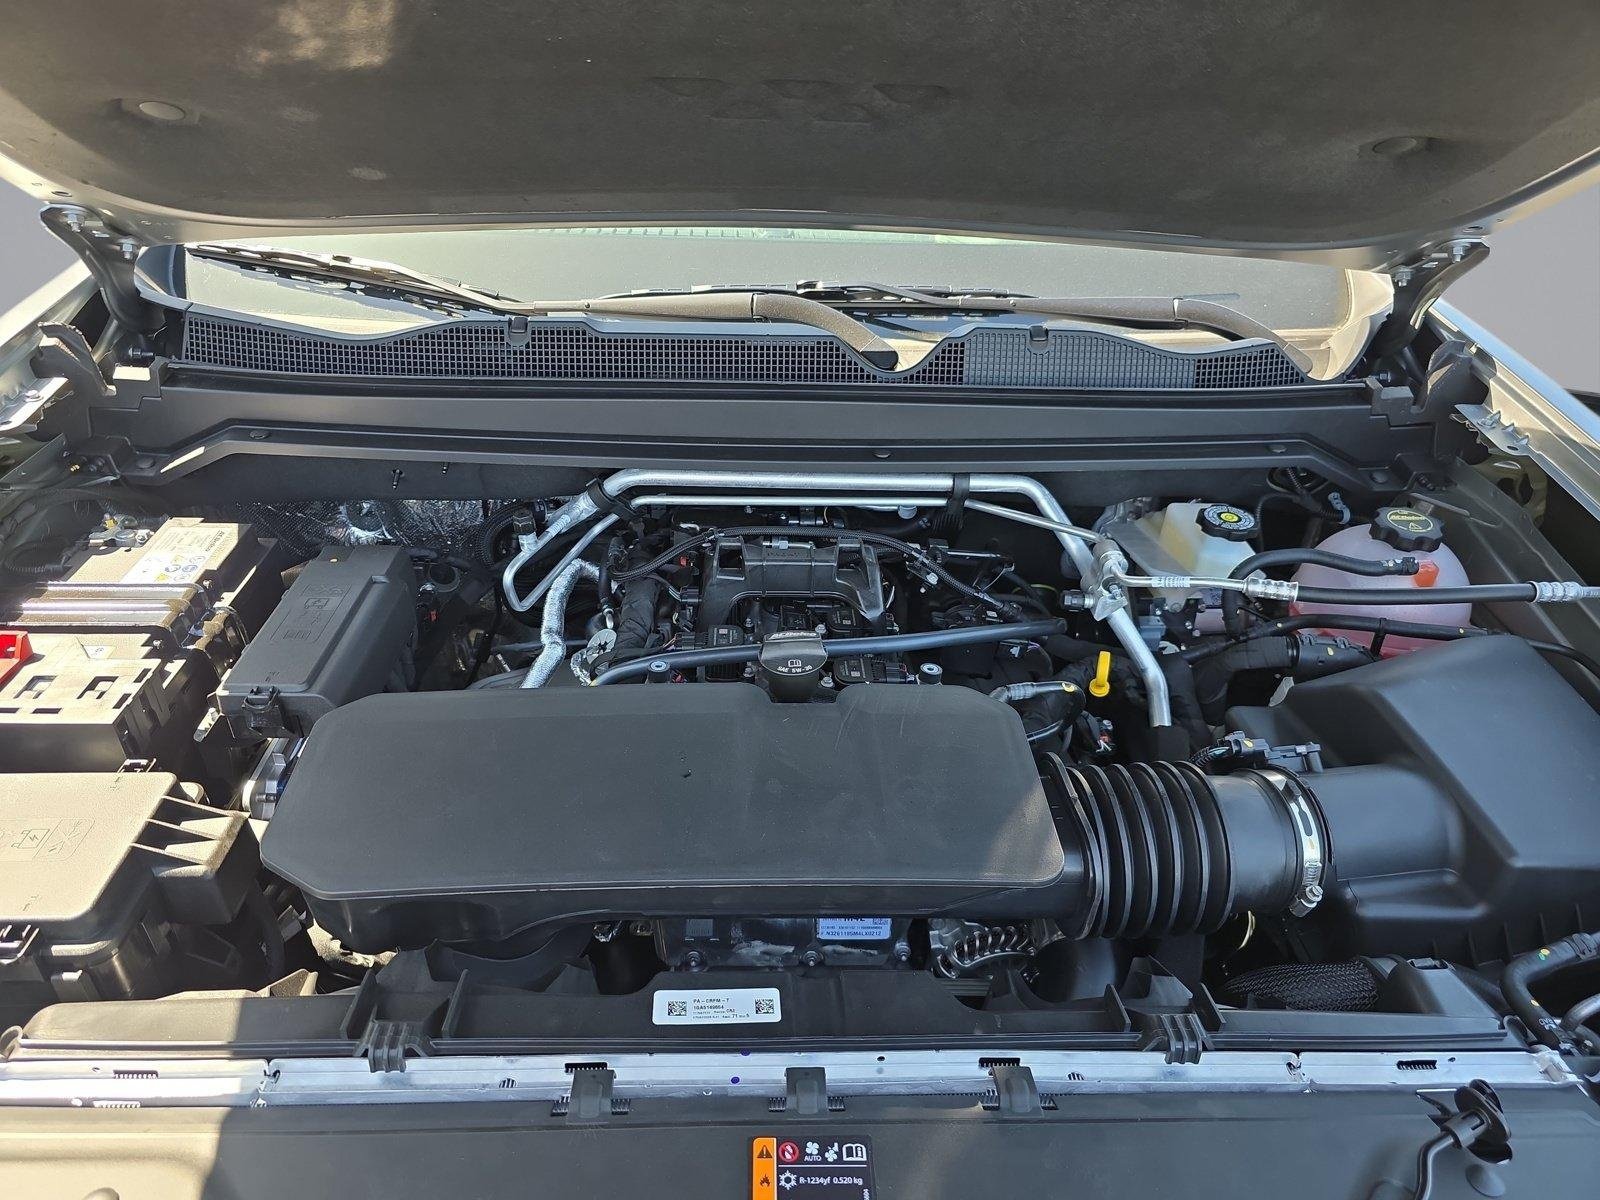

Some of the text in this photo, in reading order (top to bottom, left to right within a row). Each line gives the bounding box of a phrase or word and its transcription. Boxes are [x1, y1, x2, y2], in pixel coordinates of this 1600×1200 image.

[777, 665, 789, 673] SAE
[799, 1176, 831, 1184] R-1234yf
[853, 1176, 863, 1186] kg
